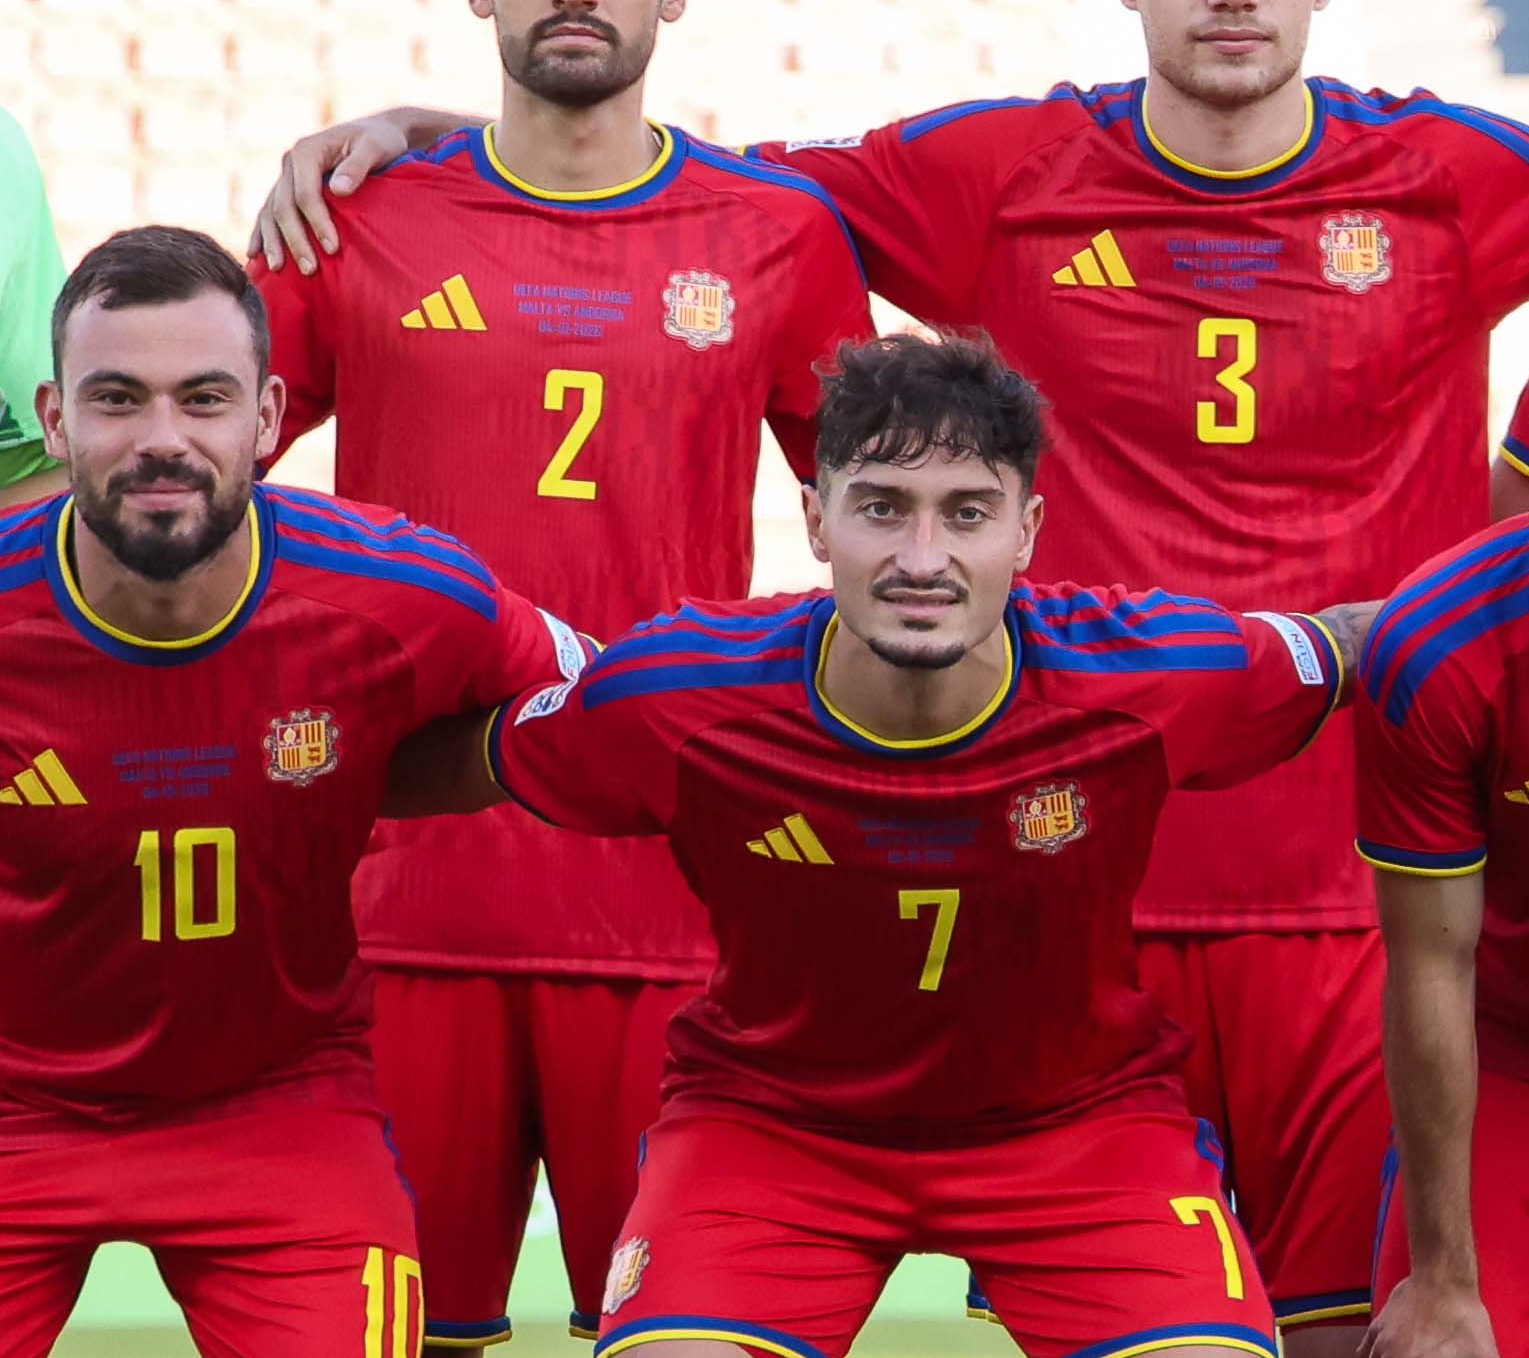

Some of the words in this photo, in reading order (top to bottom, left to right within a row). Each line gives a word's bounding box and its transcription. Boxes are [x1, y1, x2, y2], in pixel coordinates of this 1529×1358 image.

[537, 369, 604, 500] 2
[1196, 318, 1258, 444] 3
[133, 826, 237, 942] 10
[899, 889, 960, 991] 7
[1169, 1196, 1244, 1300] 7
